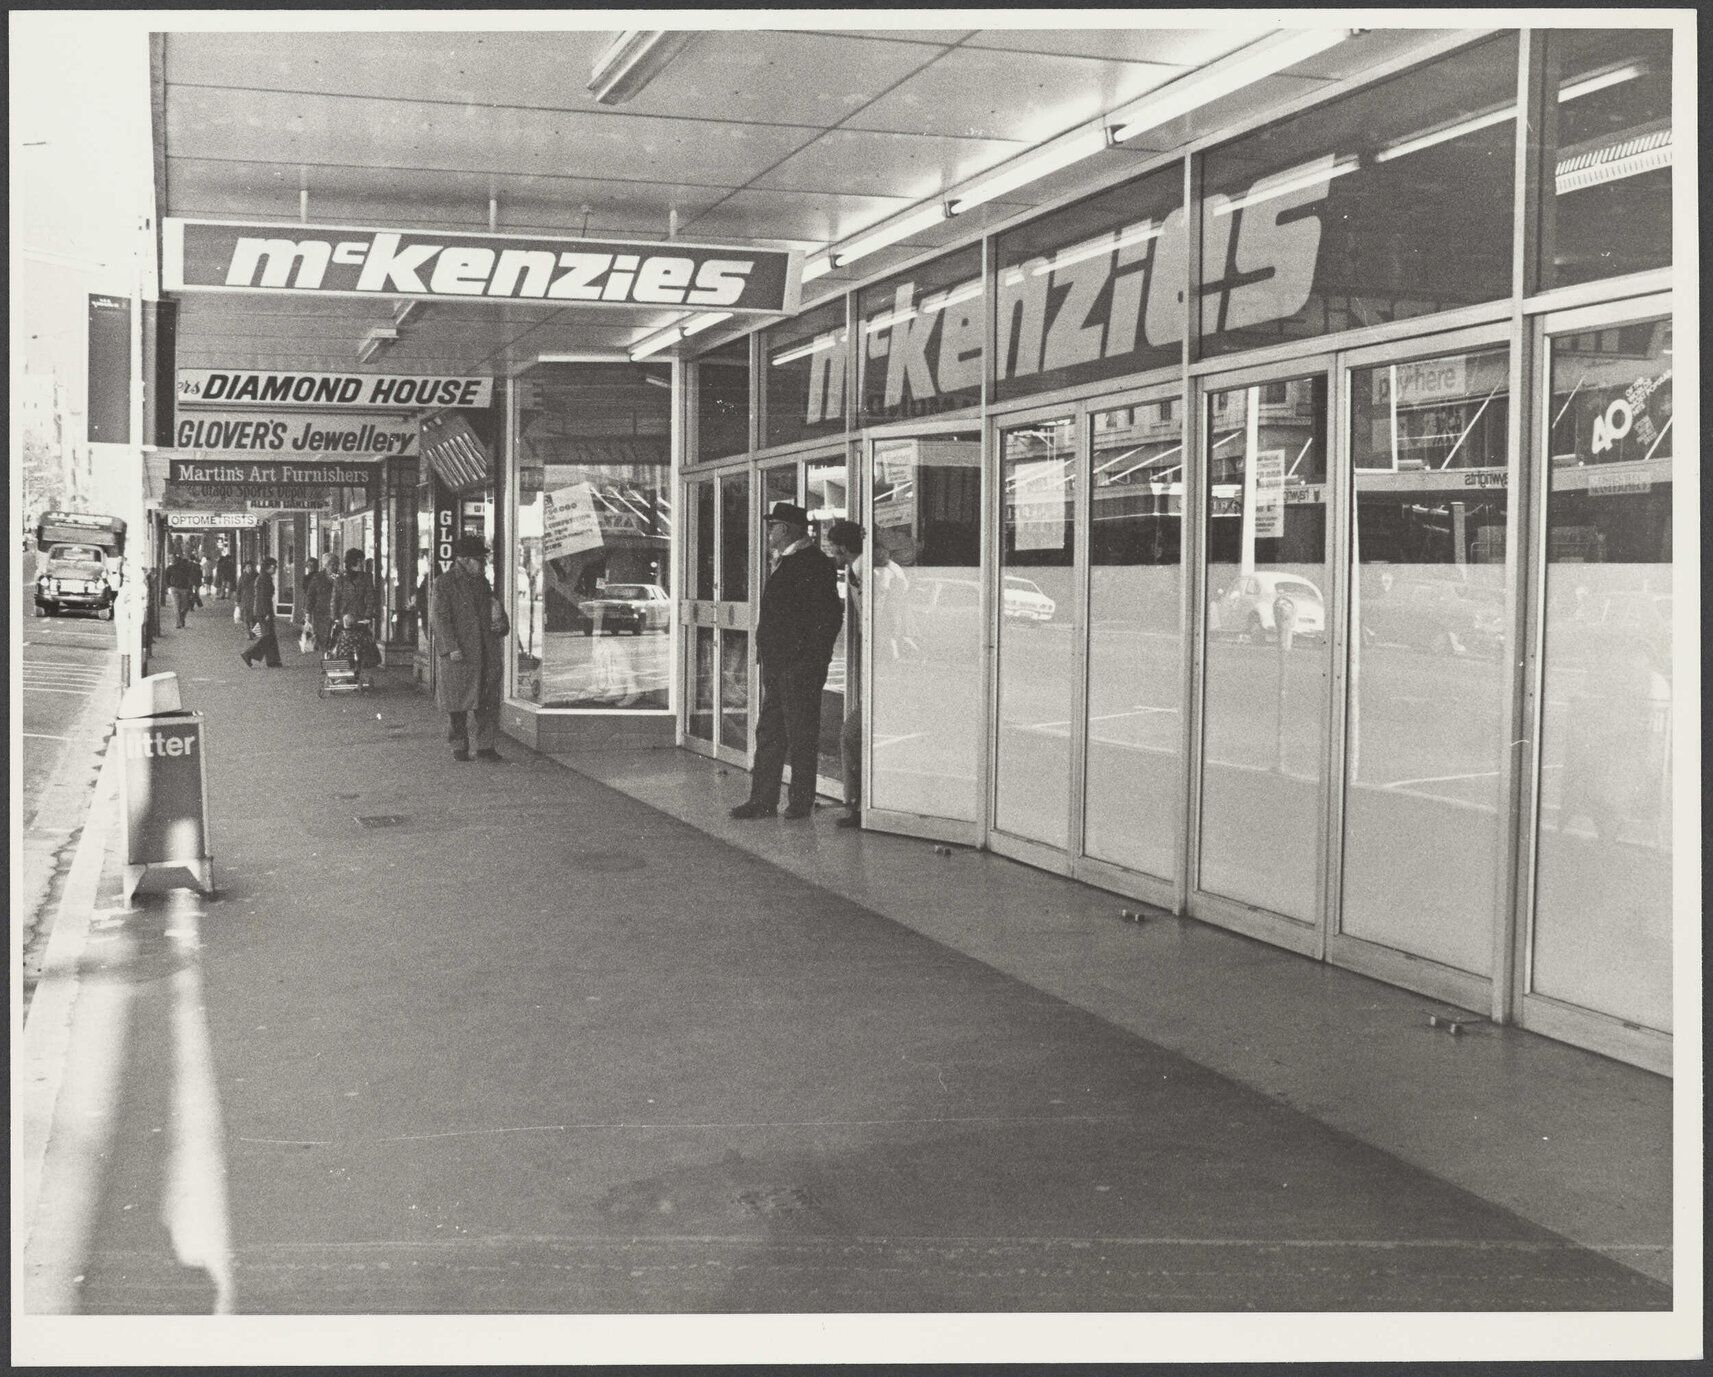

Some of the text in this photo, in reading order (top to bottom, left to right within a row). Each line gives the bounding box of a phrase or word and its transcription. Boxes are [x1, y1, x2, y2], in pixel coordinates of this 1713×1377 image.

[202, 374, 363, 403] DIAMOND
[369, 378, 481, 405] HOUSE
[1379, 374, 1411, 402] py
[178, 418, 416, 454] GLOVER'S Jewellery
[1592, 399, 1633, 454] 40
[178, 464, 370, 483] Martin's Art Furnishers
[171, 515, 255, 526] OPTOMETRISTS
[128, 731, 196, 758] tter
